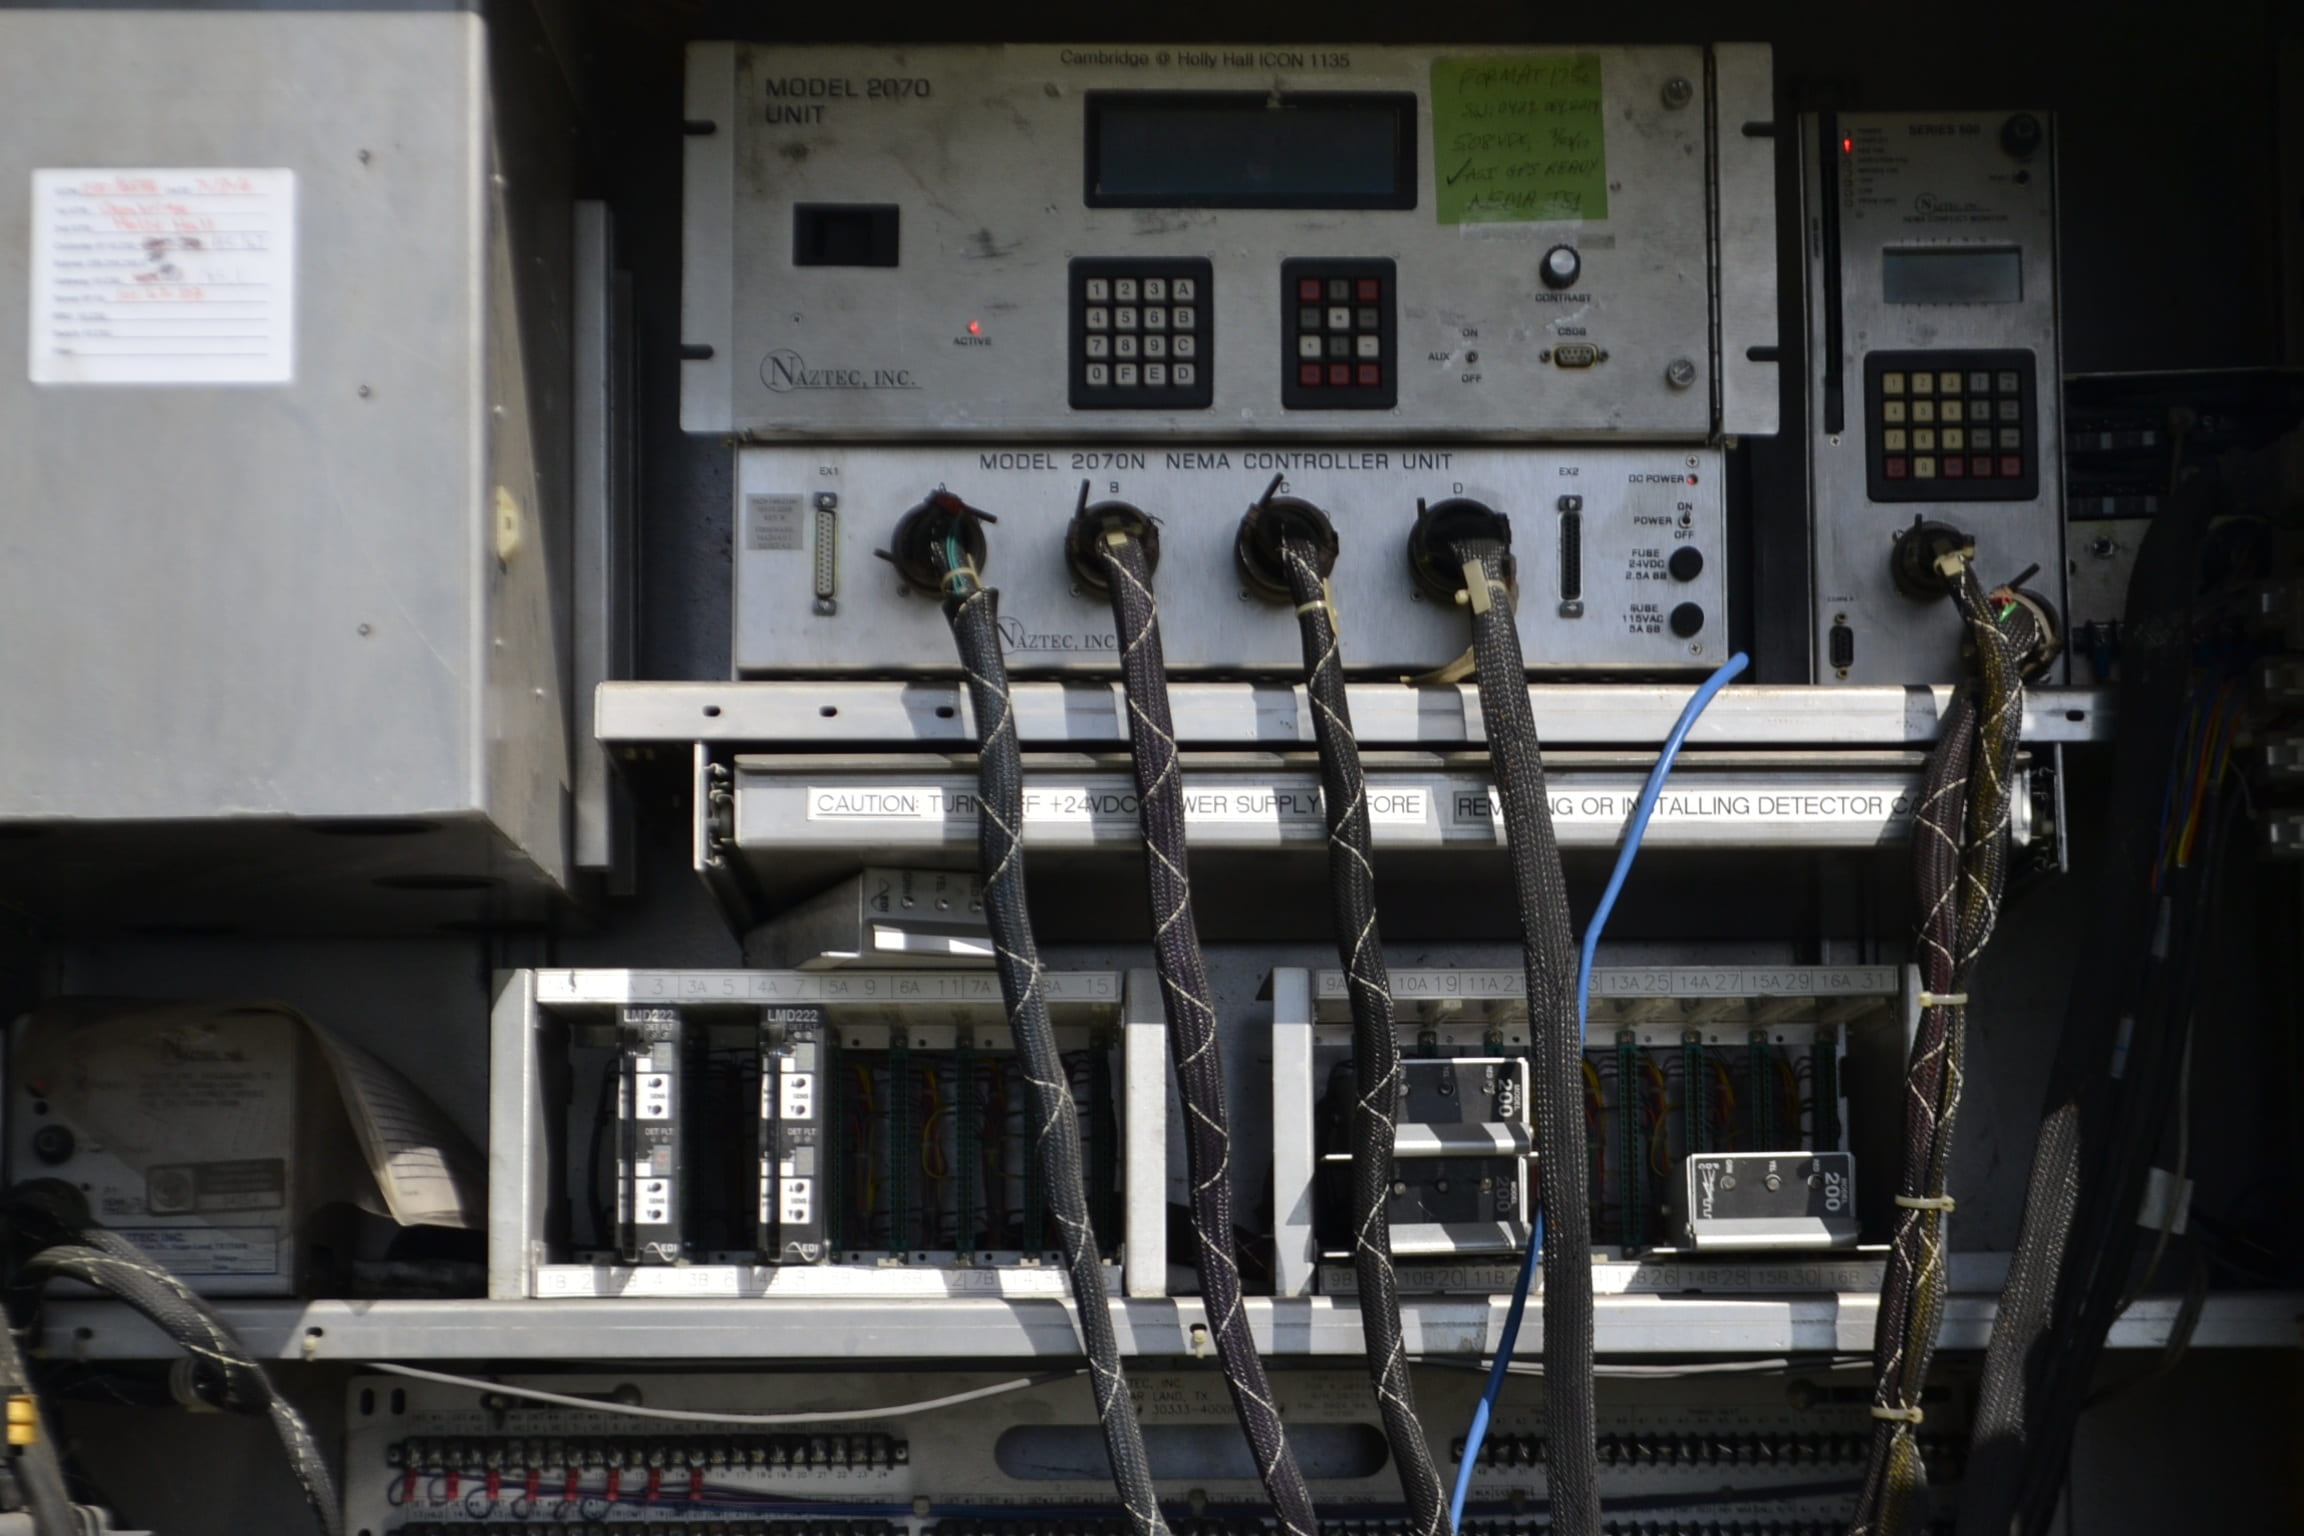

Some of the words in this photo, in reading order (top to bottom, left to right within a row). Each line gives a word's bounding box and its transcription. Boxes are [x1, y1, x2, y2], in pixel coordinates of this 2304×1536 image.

[1060, 49, 1148, 67] Cambridge
[1178, 52, 1217, 68] Holly
[1223, 52, 1254, 67] Hall
[1259, 53, 1303, 67] ICON
[1312, 53, 1350, 68] 1135
[765, 78, 858, 97] MODEL
[866, 78, 931, 98] 2070
[765, 104, 826, 124] UNIT
[1093, 282, 1100, 295] 1
[1121, 282, 1130, 295] 2
[1150, 282, 1159, 295] 3
[1178, 282, 1189, 295] A
[1535, 293, 1592, 303] CONTRAST
[1092, 310, 1101, 324] 4
[1121, 310, 1130, 324] 5
[1150, 310, 1159, 324] 6
[1178, 310, 1189, 324] B
[1462, 328, 1478, 337] ON
[952, 337, 993, 346] ACTIVE
[1092, 339, 1101, 352] 7
[1121, 339, 1130, 352] 8
[1150, 339, 1159, 352] 9
[1178, 339, 1189, 352] C
[1428, 352, 1450, 361] AUX
[874, 371, 916, 386] INC.
[1092, 367, 1101, 380] 0
[1121, 367, 1130, 380] F
[1150, 367, 1159, 380] E
[1178, 367, 1189, 380] D
[1461, 374, 1482, 383] OFF
[980, 453, 1058, 470] MODEL
[1072, 453, 1146, 470] 2070N
[1166, 453, 1231, 470] NEMA
[1244, 453, 1389, 470] CONTROLLER
[1402, 453, 1453, 470] UNIT
[1629, 474, 1644, 484] DC
[1646, 474, 1685, 484] POWER
[1110, 481, 1120, 494] B
[1280, 482, 1291, 494] C
[1453, 482, 1464, 494] D
[1677, 502, 1693, 511] ON
[1633, 516, 1673, 525] POWER
[1674, 531, 1695, 540] OFF
[817, 794, 920, 813] CAUTION:
[928, 795, 979, 813] TURN
[1049, 795, 1137, 814] +24VDC
[1183, 795, 1228, 814] WER
[1235, 795, 1320, 814] SUPPLY
[1366, 795, 1421, 814] FORE
[1581, 797, 1614, 815] OR
[1622, 797, 1750, 815] INTALLING
[1758, 796, 1883, 816] DETECTOR
[1086, 978, 1110, 995] 15
[1398, 976, 1428, 991] 10A
[1434, 976, 1458, 992] 19
[1610, 975, 1640, 990] 13A
[1644, 974, 1670, 991] 25
[1682, 975, 1710, 990] 14A
[1716, 974, 1740, 991] 27
[1752, 975, 1780, 989] 15A
[1784, 974, 1810, 990] 29
[1822, 974, 1852, 988] 16A
[623, 1009, 675, 1023] LMD222
[767, 1009, 819, 1023] LMD222
[1498, 1078, 1513, 1118] 200
[1496, 1175, 1511, 1212] 200
[1824, 1171, 1841, 1212] 200
